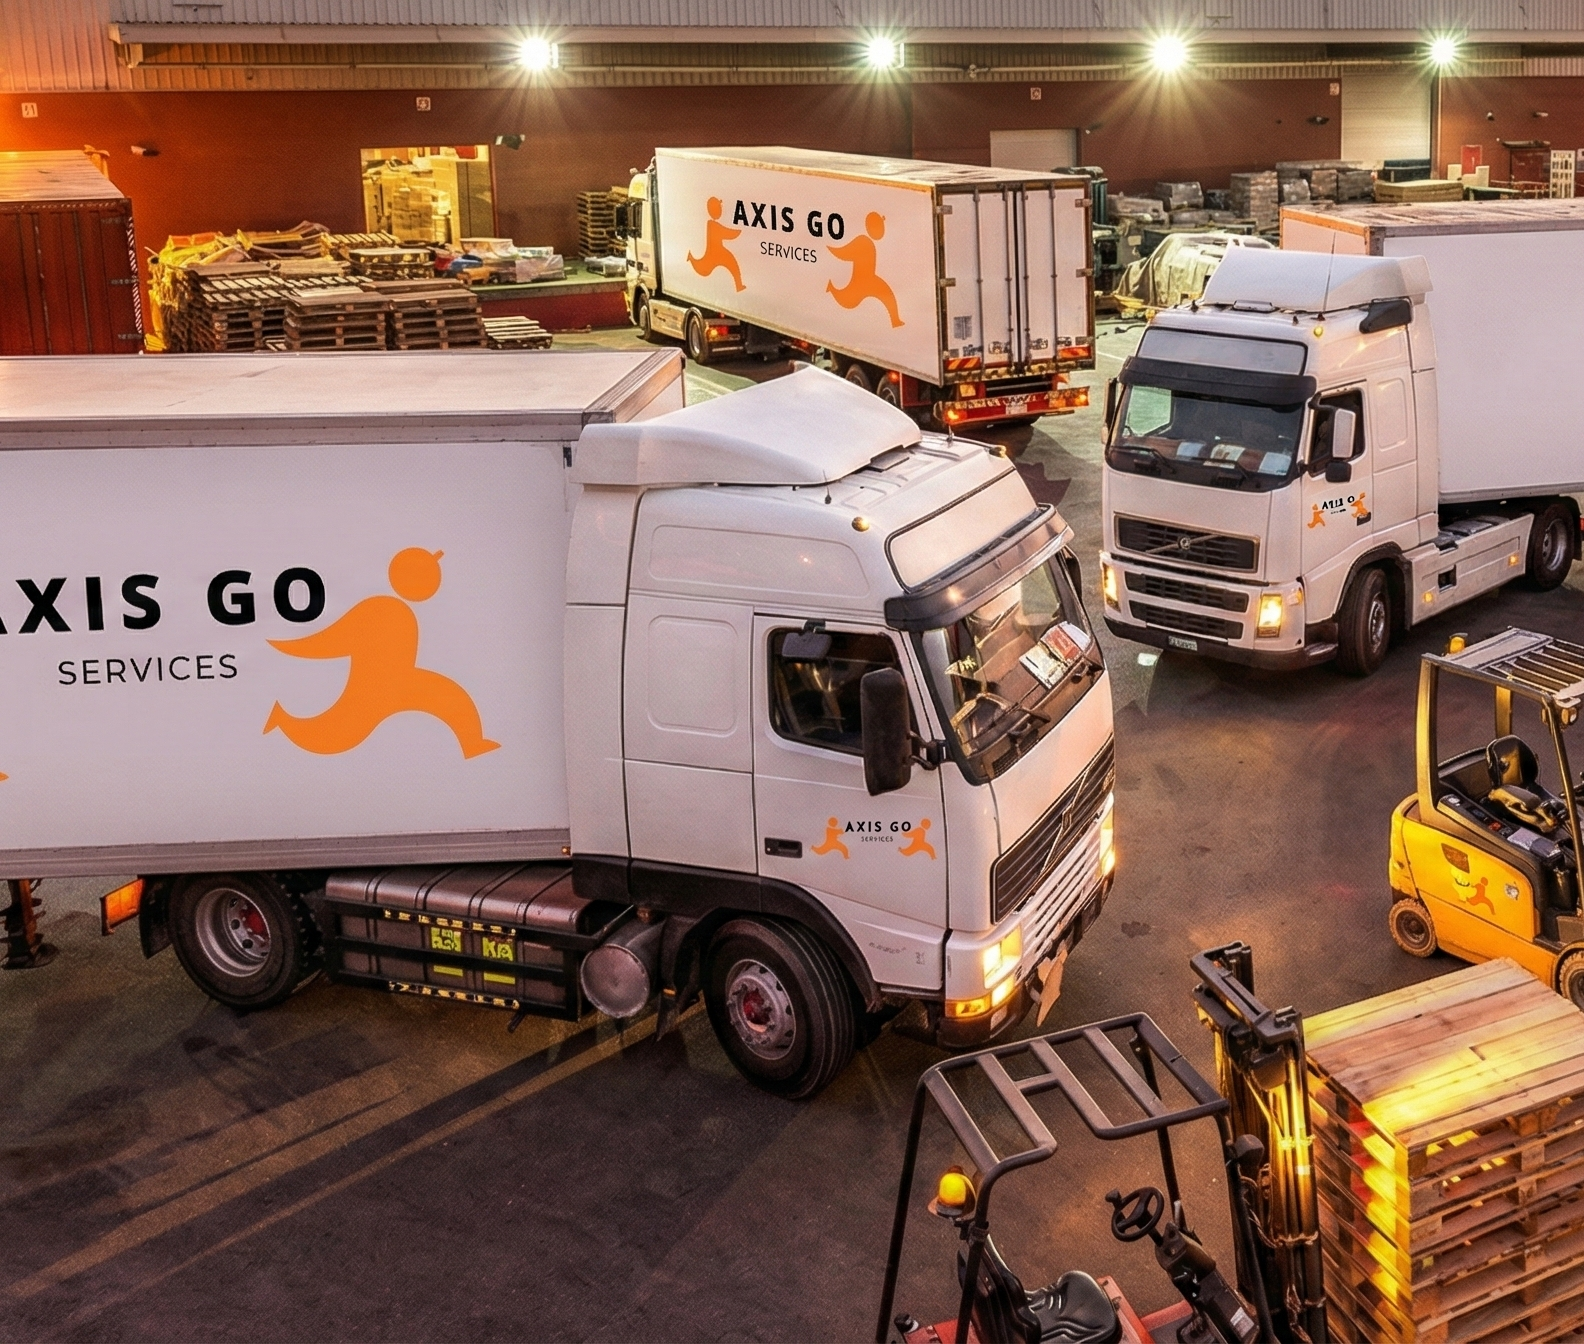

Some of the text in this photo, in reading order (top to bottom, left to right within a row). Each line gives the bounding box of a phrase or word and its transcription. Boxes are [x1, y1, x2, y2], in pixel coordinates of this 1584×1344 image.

[732, 199, 845, 241] AXIS GO
[760, 241, 818, 264] SERVICES
[0, 567, 326, 635] XIS GO
[58, 654, 238, 686] SERVICES
[845, 820, 912, 833] AXIS GO
